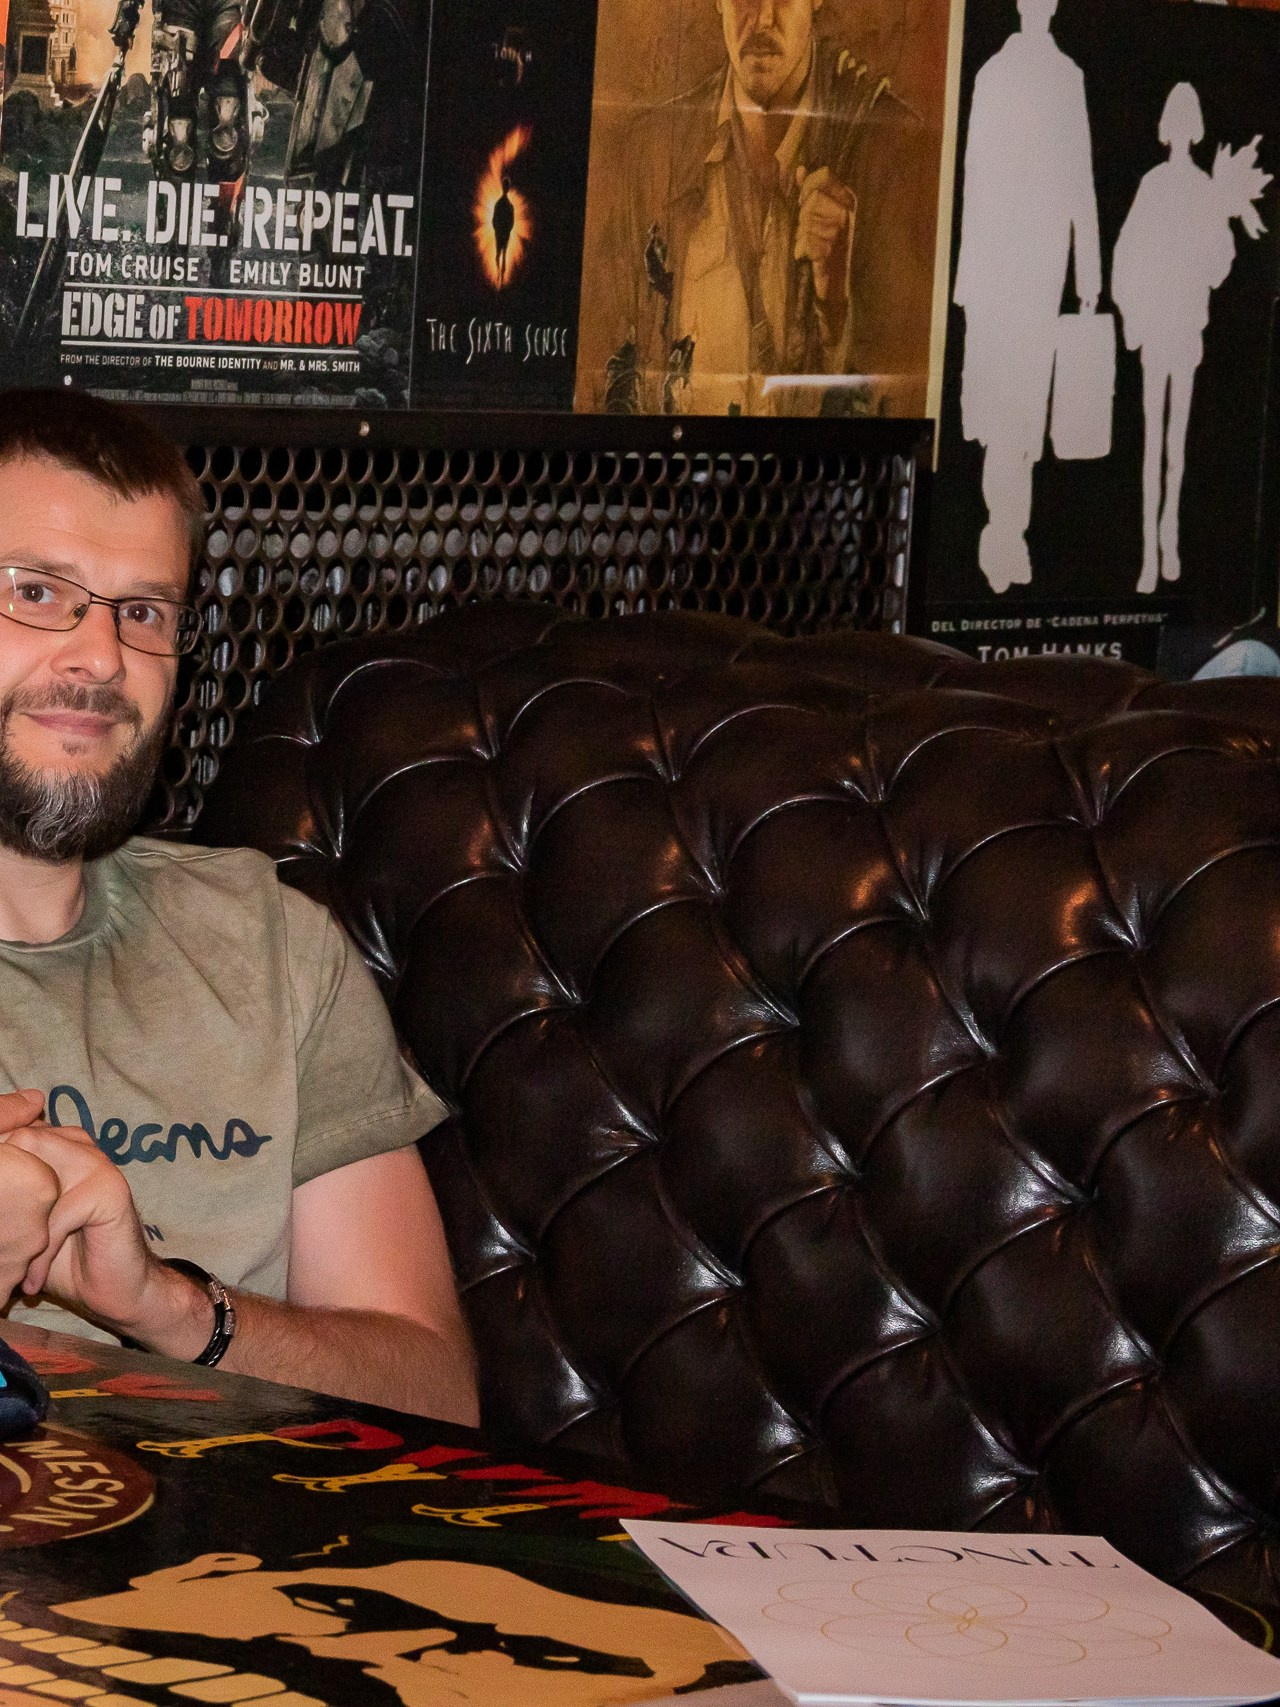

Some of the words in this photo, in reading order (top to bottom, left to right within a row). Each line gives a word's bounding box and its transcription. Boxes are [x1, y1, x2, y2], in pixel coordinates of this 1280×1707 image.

[16, 172, 131, 241] LIVE.
[146, 180, 228, 248] DIE.
[242, 186, 413, 257] REPEAT.
[67, 251, 111, 278] TOM
[121, 254, 200, 282] CRUISE
[229, 259, 292, 286] EMILY
[299, 263, 366, 289] BLUNT
[61, 291, 145, 339] EDGE
[149, 304, 181, 340] OF
[184, 296, 363, 345] TOMORROW
[426, 319, 457, 353] THE
[466, 317, 512, 365] SIXTH
[60, 354, 83, 364] FROM
[85, 355, 100, 365] THE
[102, 356, 141, 366] DIRECTOR
[142, 357, 153, 366] OF
[155, 355, 173, 367] THE
[176, 356, 216, 368] BOURNE
[218, 357, 261, 370] IDENTITY
[262, 360, 278, 370] AND
[280, 359, 296, 371] MR.
[299, 360, 306, 371] &
[308, 360, 330, 372] MRS.
[332, 361, 360, 372] SMITH
[931, 620, 956, 632] DEL
[961, 619, 1021, 631] DIRECTOR
[1026, 618, 1042, 629] DE
[977, 645, 1029, 664] TOM
[4, 1440, 125, 1526] MESON
